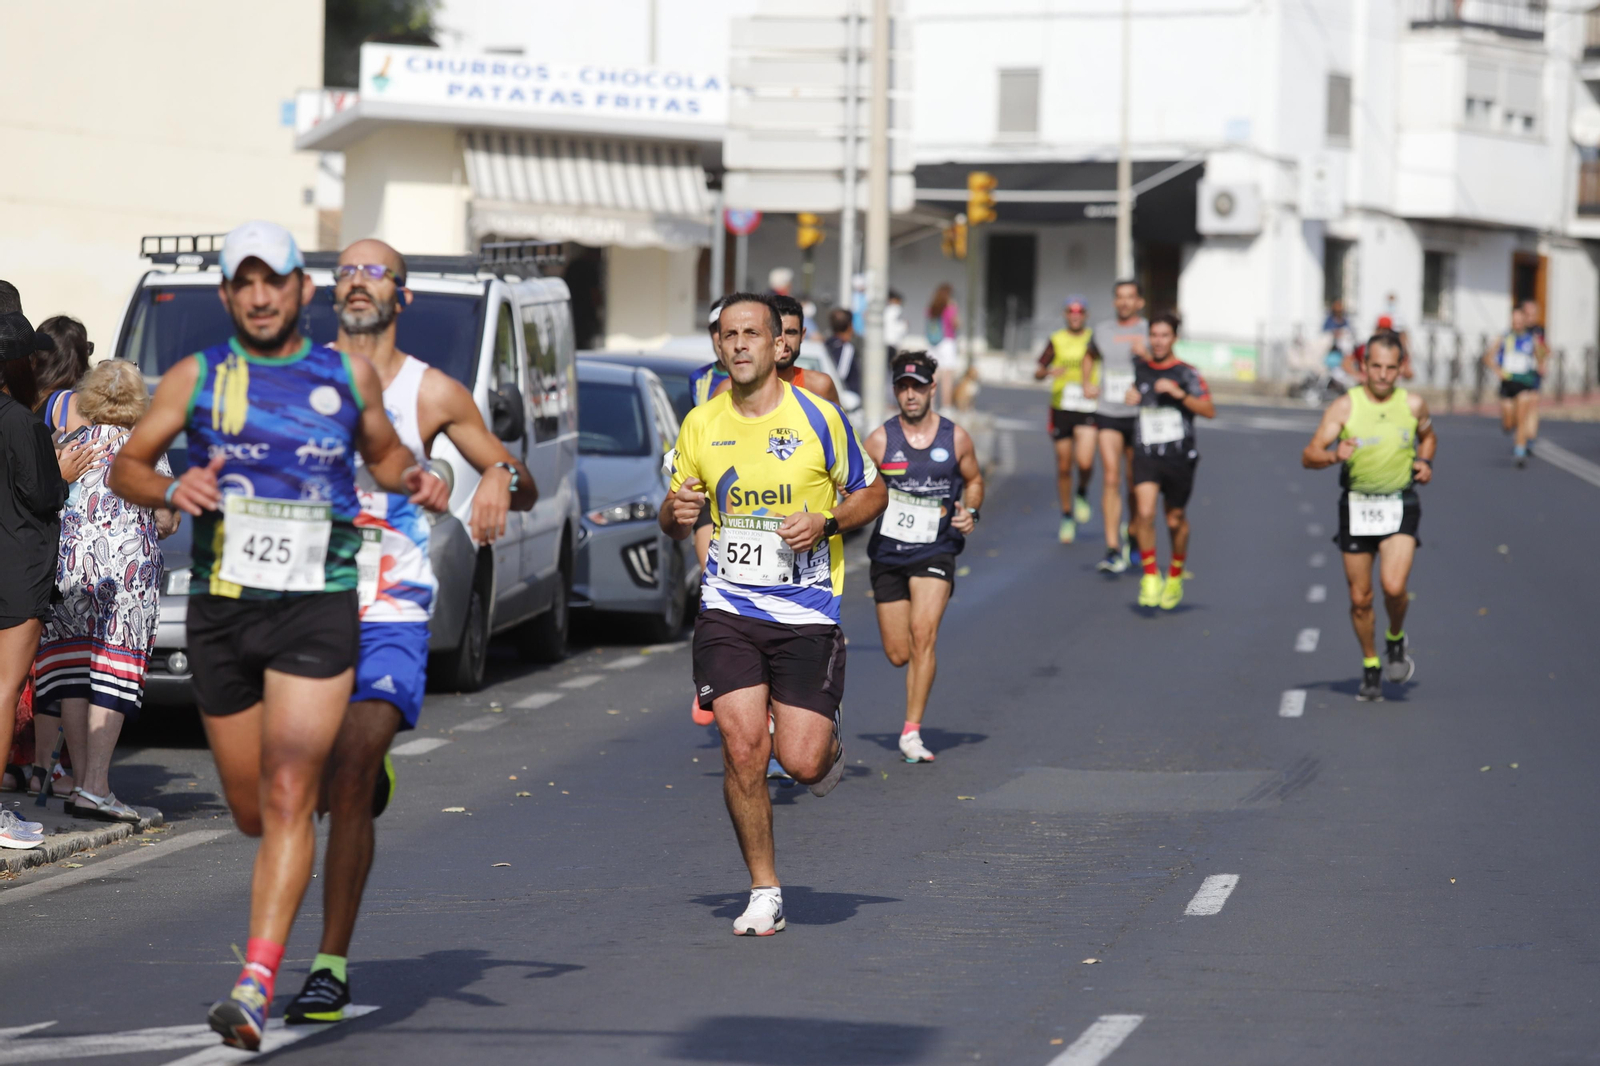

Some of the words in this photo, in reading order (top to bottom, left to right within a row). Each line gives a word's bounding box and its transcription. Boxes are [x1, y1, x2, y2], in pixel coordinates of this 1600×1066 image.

[405, 55, 551, 81] CHURROS
[448, 83, 584, 107] PATATAS
[595, 92, 701, 115] FRITAS
[730, 484, 792, 508] Snell
[728, 518, 755, 529] VUELTA
[756, 520, 761, 529] A
[897, 512, 916, 530] 29
[1361, 510, 1385, 524] 155
[243, 535, 292, 564] 425
[727, 542, 762, 566] 521
